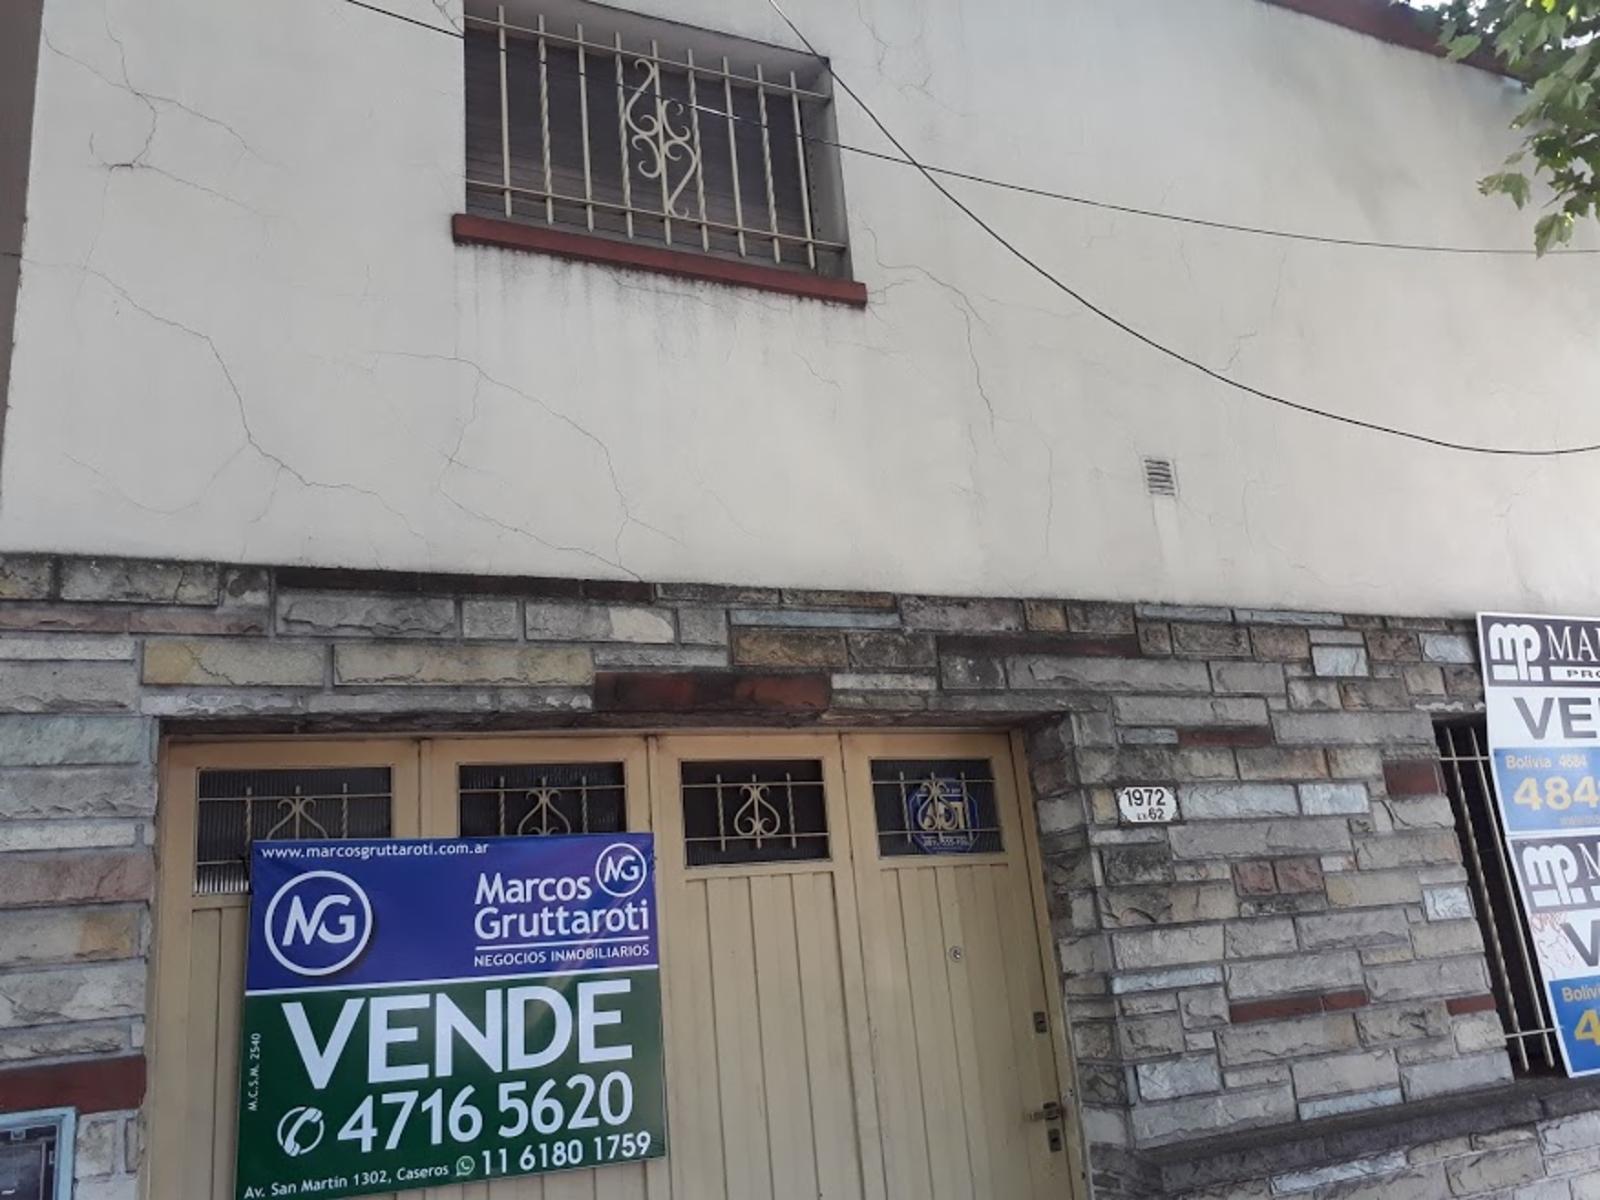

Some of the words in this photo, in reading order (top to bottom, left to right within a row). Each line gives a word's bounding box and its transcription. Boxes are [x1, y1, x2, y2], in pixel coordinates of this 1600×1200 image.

[1544, 624, 1600, 662] MA
[1513, 696, 1600, 740] VE
[1124, 788, 1166, 807] 1972
[1513, 775, 1600, 812] 484
[261, 842, 489, 860] www.marcosgruttaroti.com.ar
[474, 872, 592, 905] Marcos
[474, 899, 649, 940] Gruttaroti
[474, 951, 546, 967] NEGOCIOS
[551, 944, 649, 962] INMOBILIARIOS
[1561, 984, 1600, 1003] Boliv
[281, 979, 632, 1090] VENDE
[337, 1085, 483, 1153] 4716
[498, 1071, 633, 1137] 5620
[482, 1149, 507, 1176] 11
[519, 1139, 583, 1171] 6180
[594, 1131, 651, 1161] 1759
[244, 1186, 266, 1199] Av.
[271, 1182, 296, 1196] San
[354, 1170, 392, 1186] 1302,
[396, 1164, 449, 1180] Caseros
